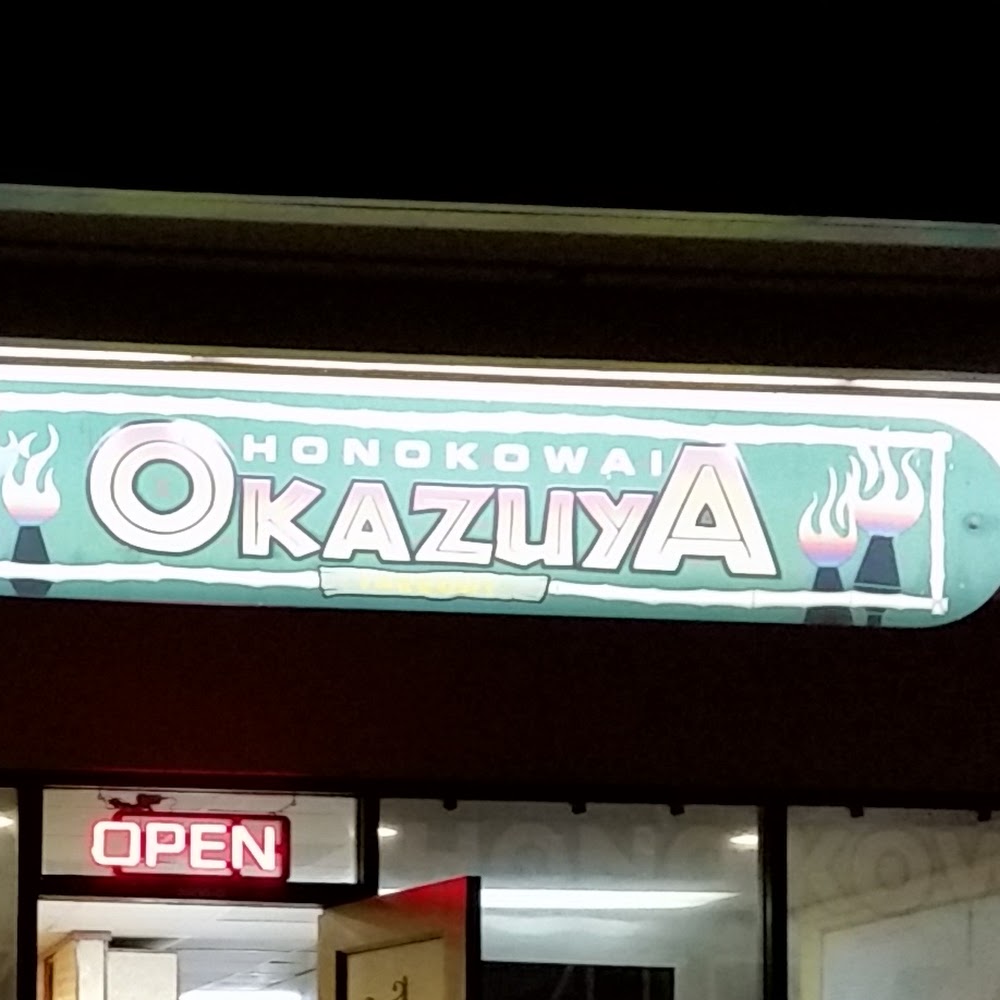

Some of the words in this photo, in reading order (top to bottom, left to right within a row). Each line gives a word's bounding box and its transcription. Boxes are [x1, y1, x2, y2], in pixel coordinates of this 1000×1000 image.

[242, 434, 662, 477] HONOKOWAI
[86, 418, 780, 579] OKAZUYA
[91, 821, 276, 871] OPEN
